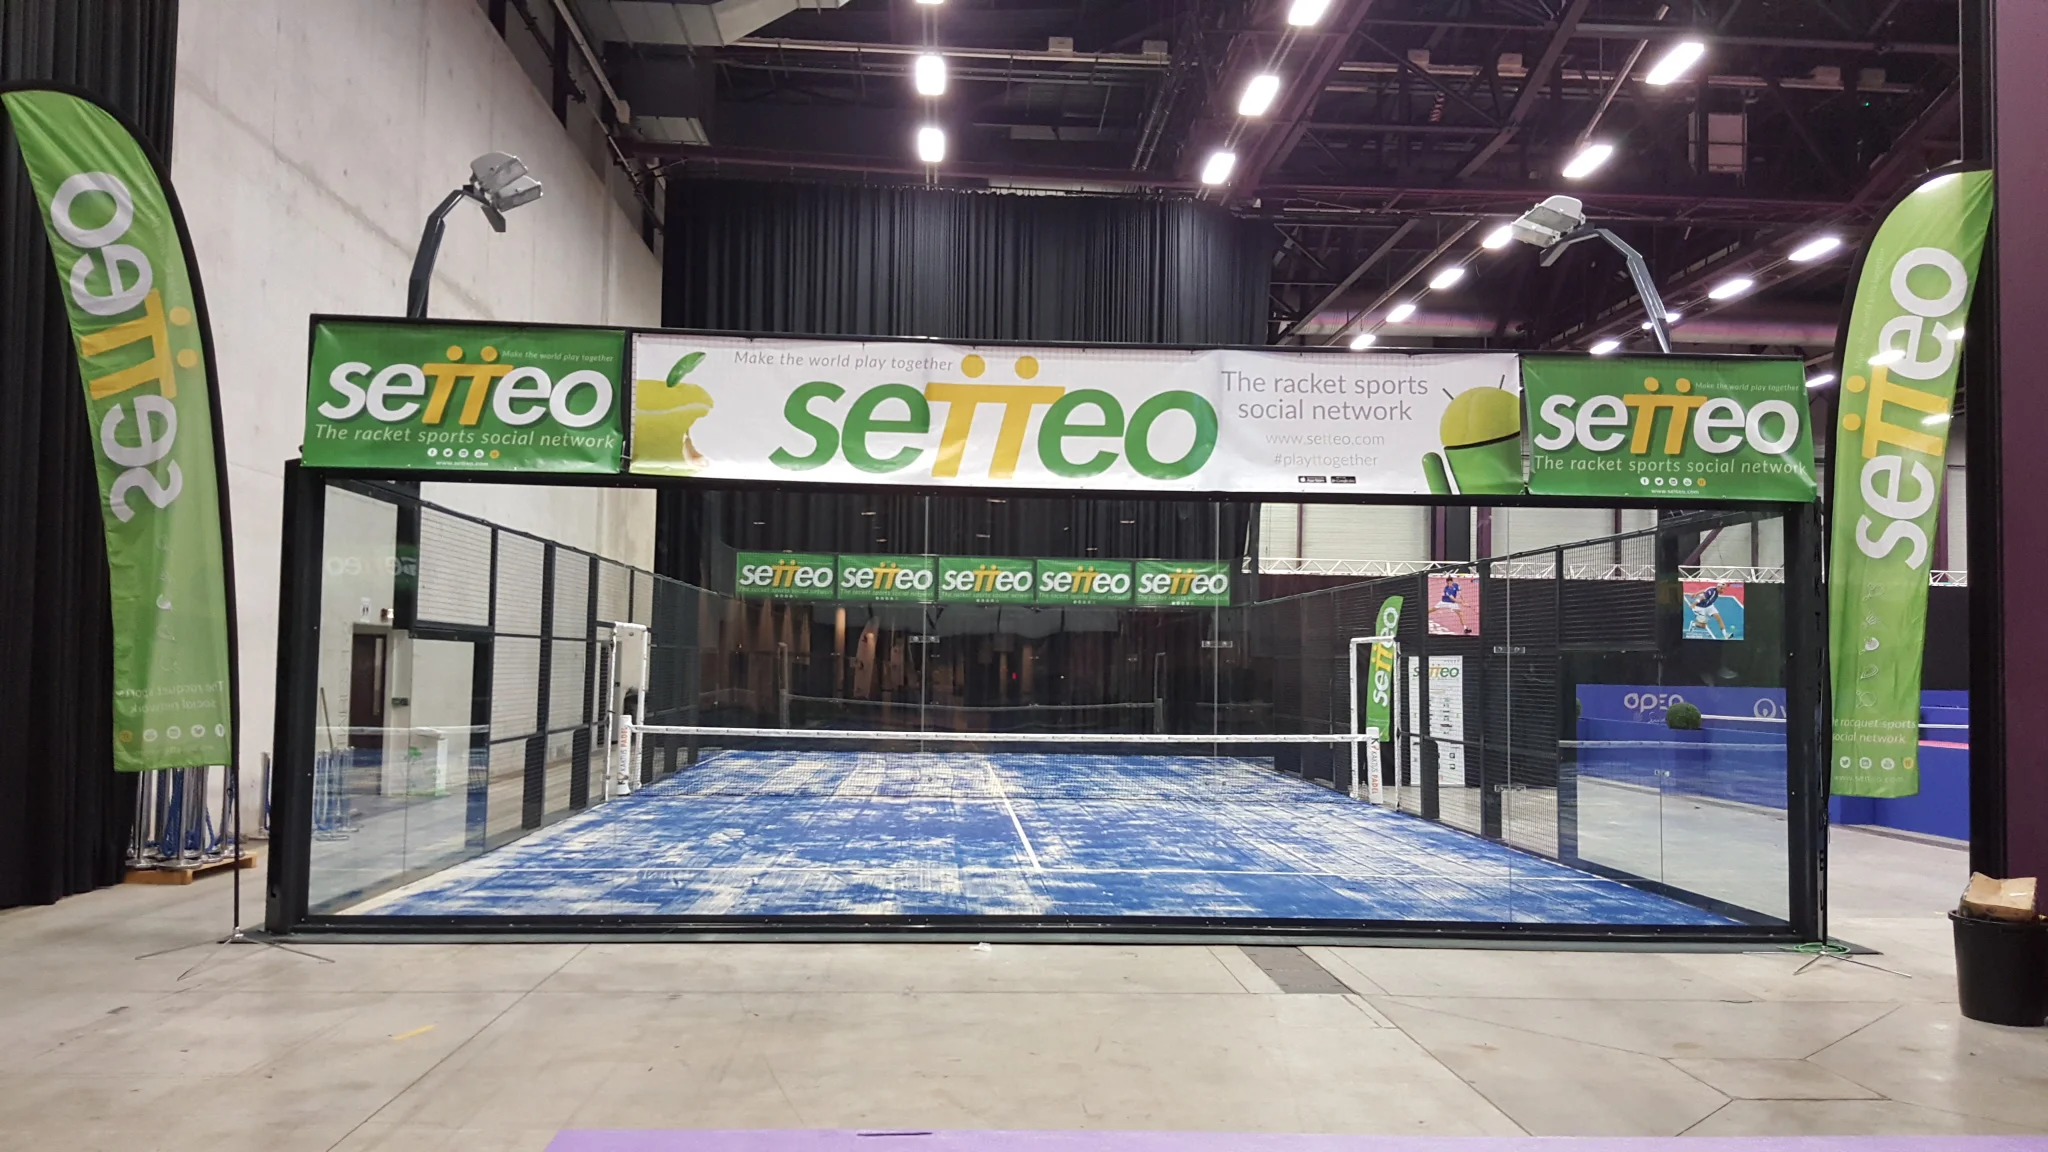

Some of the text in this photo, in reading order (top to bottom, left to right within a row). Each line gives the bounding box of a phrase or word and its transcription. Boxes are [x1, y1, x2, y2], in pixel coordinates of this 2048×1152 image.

[501, 350, 523, 358] Make
[525, 350, 537, 359] the
[563, 353, 580, 362] play
[582, 354, 614, 362] together
[734, 350, 953, 372] Make the world play together
[1221, 370, 1428, 399] The racket sports
[1716, 382, 1727, 390] the
[1750, 384, 1766, 392] play
[1768, 384, 1800, 392] together
[1238, 398, 1413, 421] social network
[315, 423, 614, 449] The racket sports social network
[1265, 433, 1385, 446] www.setteo.com
[1274, 453, 1378, 469] #playttogether
[1534, 455, 1807, 475] The racket sports social network
[1840, 719, 1879, 729] racquet
[1881, 720, 1916, 731] sports
[1860, 734, 1906, 744] network
[1371, 774, 1379, 794] PADEL
